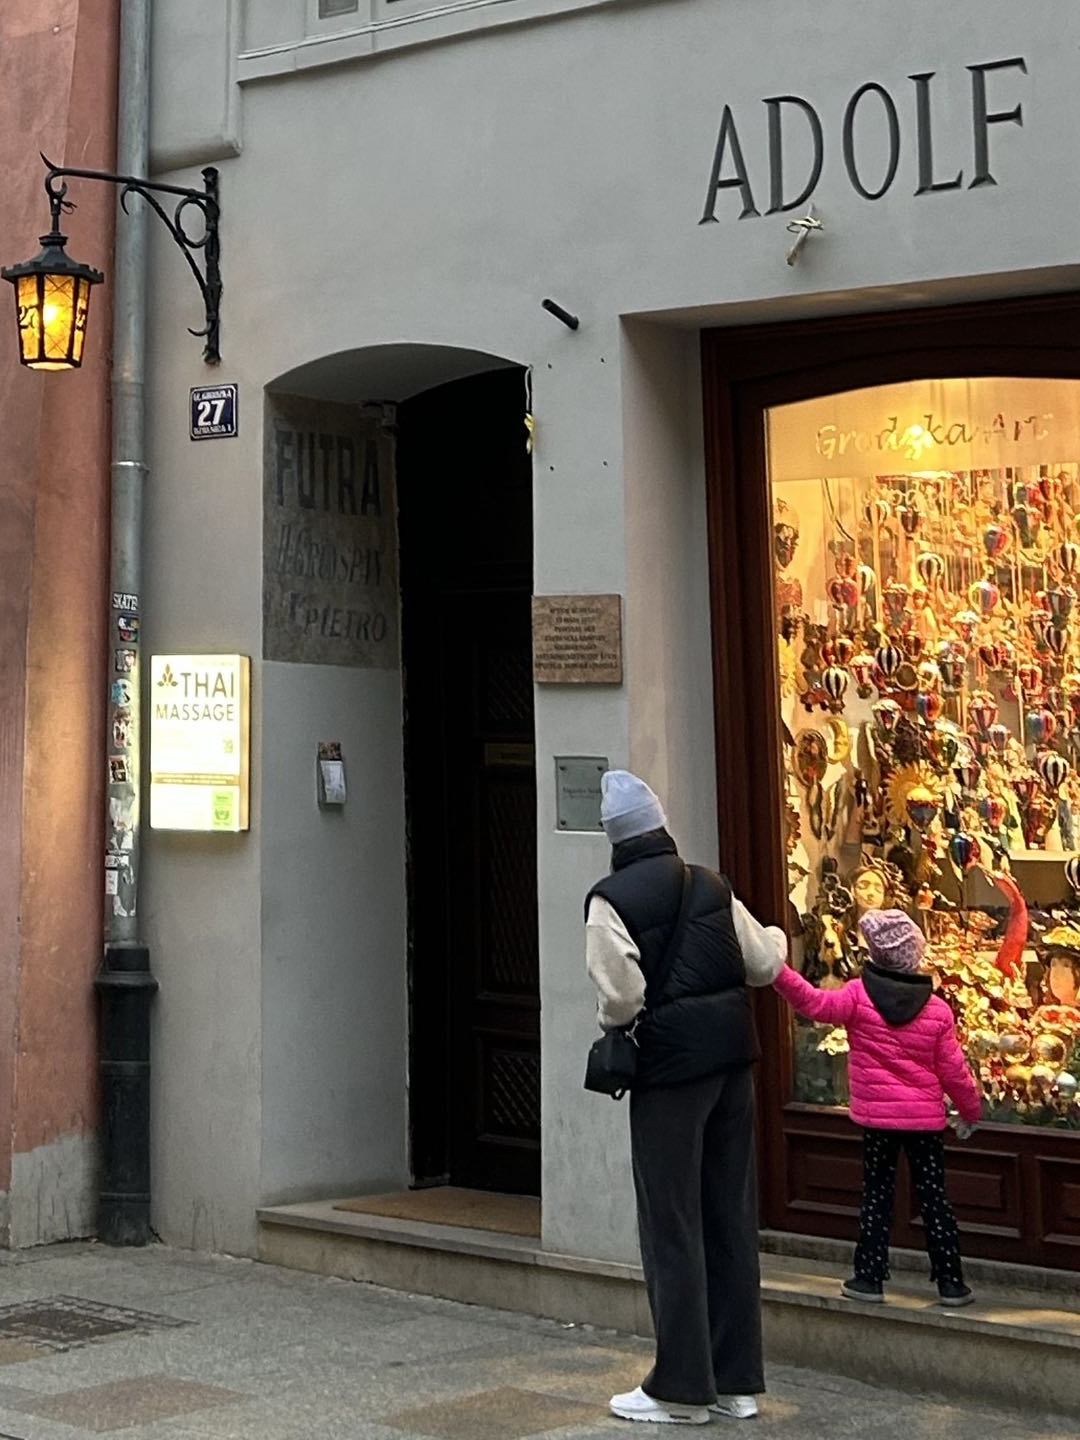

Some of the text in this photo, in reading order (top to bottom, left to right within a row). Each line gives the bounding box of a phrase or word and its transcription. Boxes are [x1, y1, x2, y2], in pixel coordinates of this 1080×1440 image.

[698, 56, 1027, 225] ADOLF
[198, 400, 225, 426] 27
[276, 430, 381, 517] FUTRA
[180, 671, 234, 698] THAI
[156, 703, 234, 721] MASSAGE
